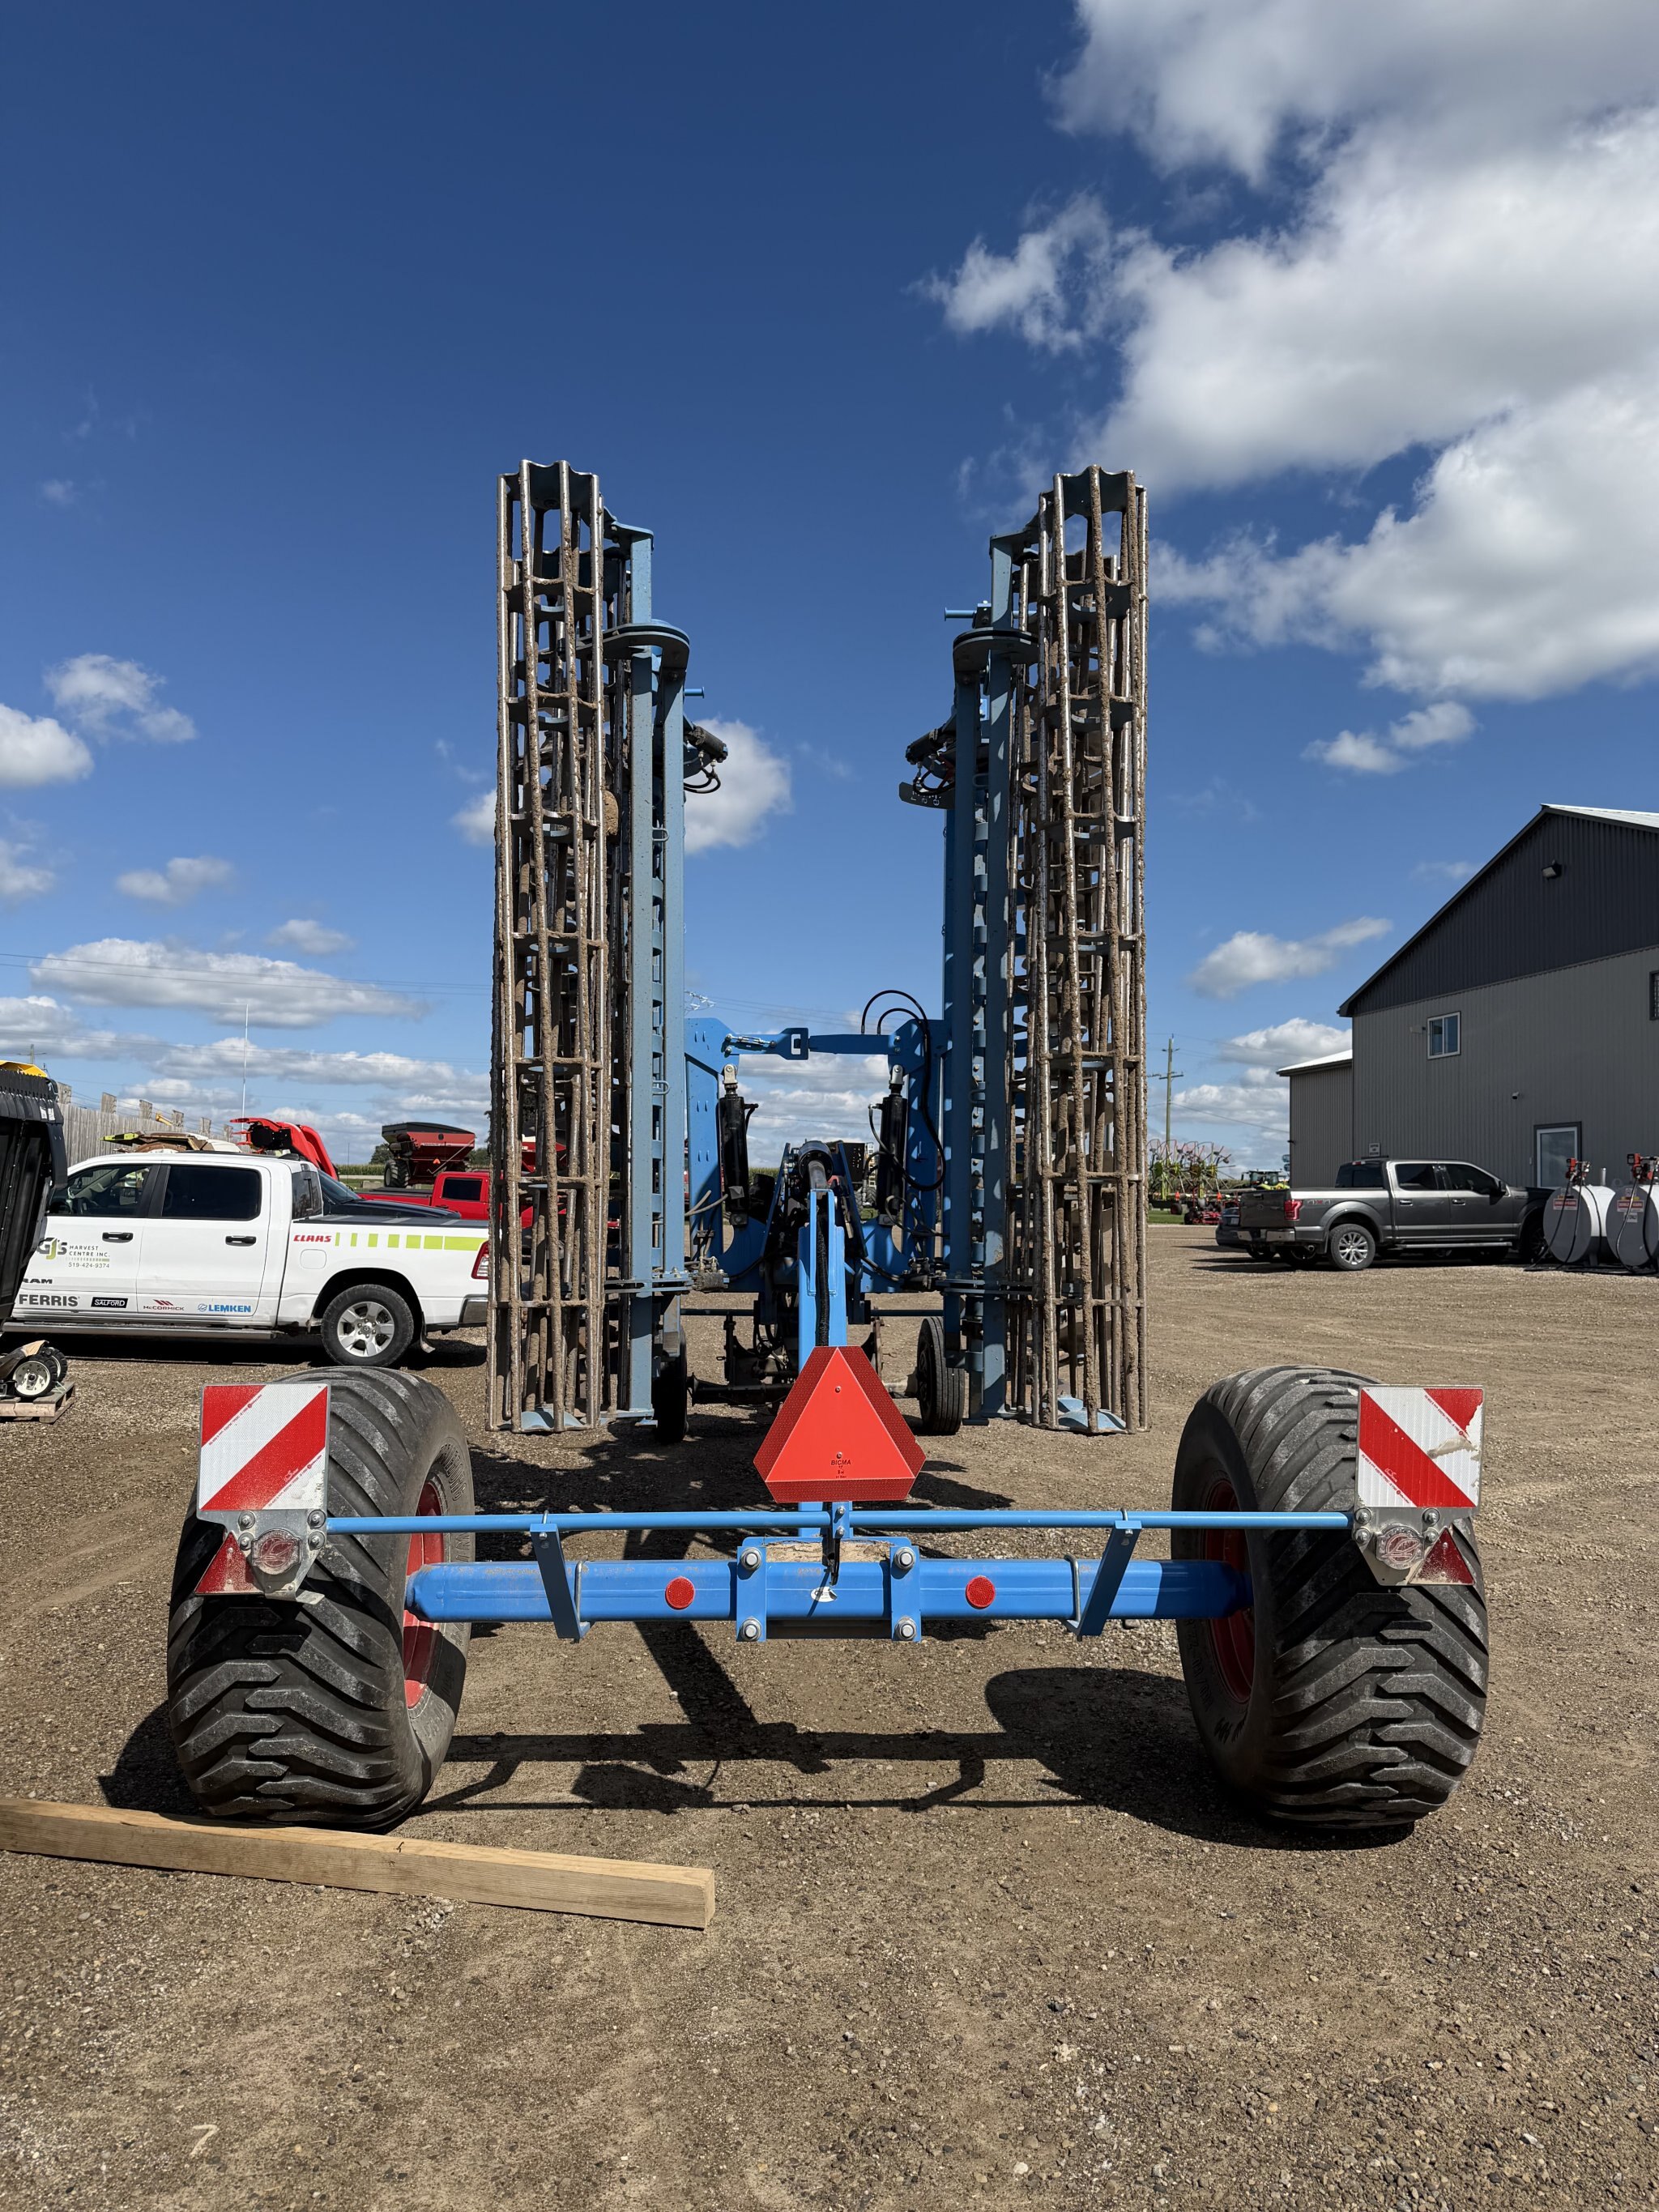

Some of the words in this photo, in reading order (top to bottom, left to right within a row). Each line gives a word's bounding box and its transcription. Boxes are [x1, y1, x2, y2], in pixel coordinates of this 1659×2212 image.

[293, 1234, 331, 1242] CLAAS
[19, 1294, 79, 1307] FERRIS
[94, 1298, 126, 1306] SALFORD
[208, 1304, 251, 1313] LEMKEN
